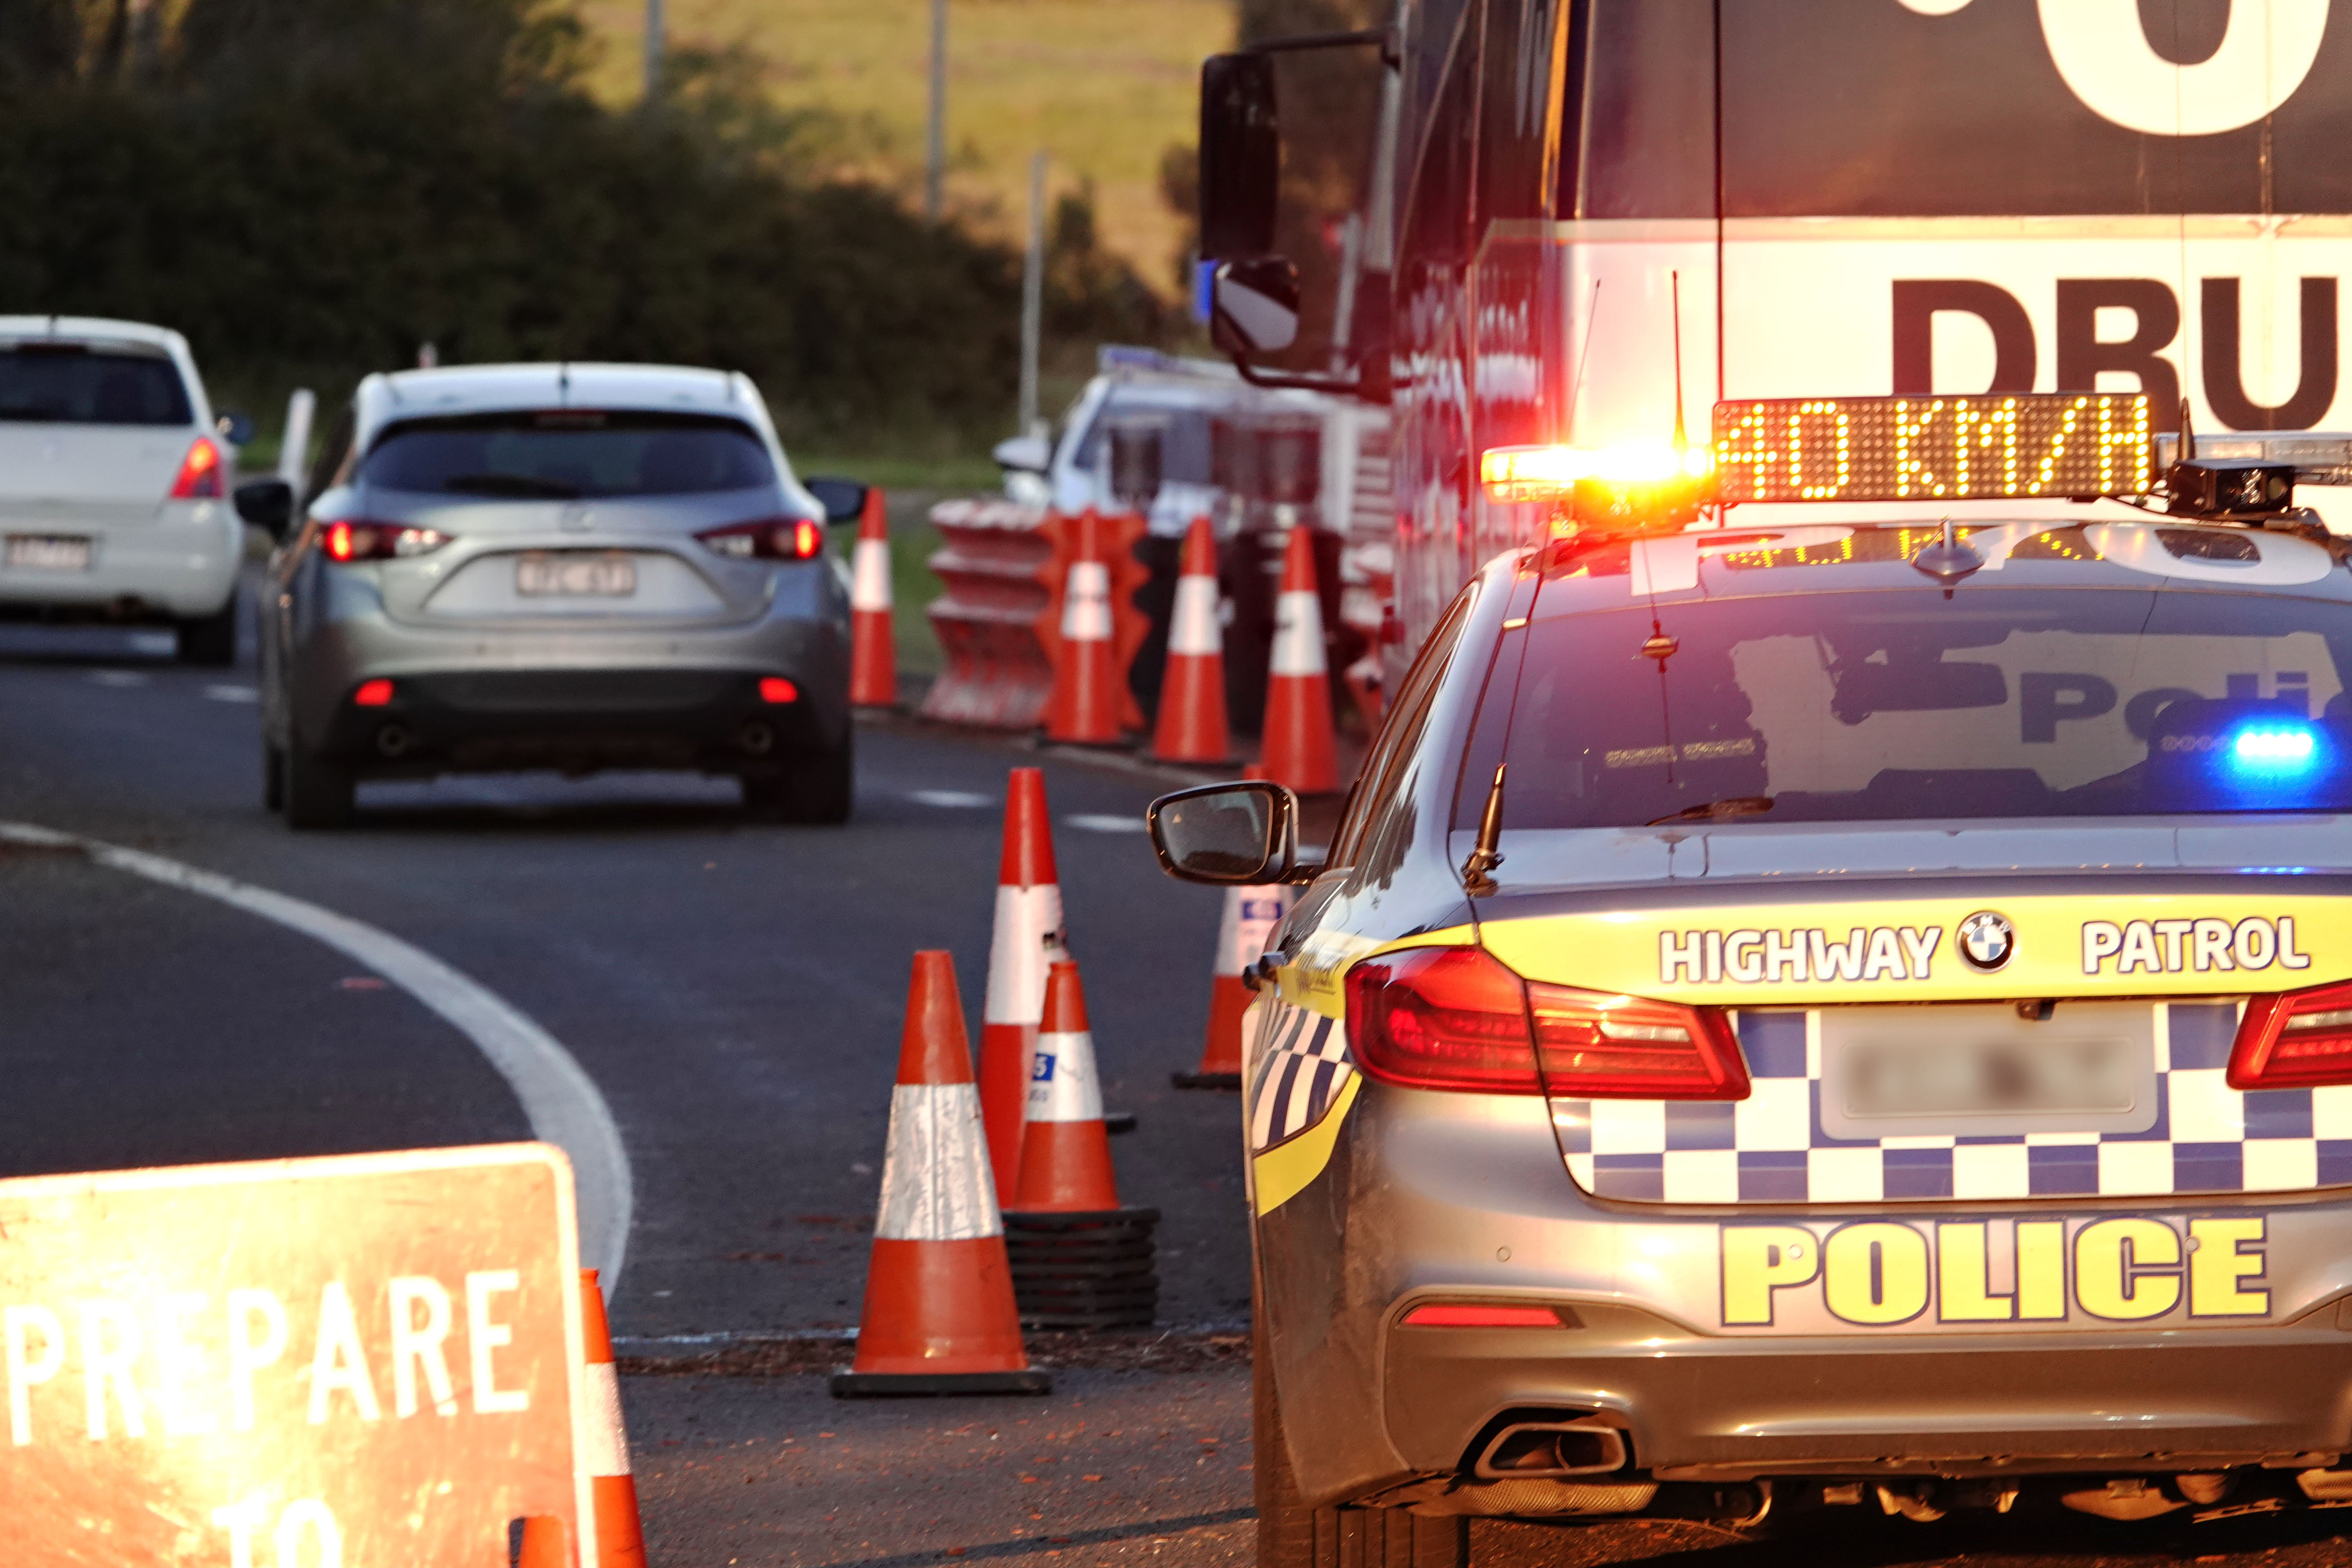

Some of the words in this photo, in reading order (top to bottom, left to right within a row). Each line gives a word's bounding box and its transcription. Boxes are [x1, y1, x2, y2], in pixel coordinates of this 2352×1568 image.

[1717, 401, 1849, 499] 40
[1896, 395, 2149, 497] KM/H
[1659, 926, 1942, 984] HIGHWAY
[2082, 916, 2311, 975] PATROL
[1720, 1215, 2273, 1327] POLICE
[4, 1269, 530, 1447] PREPARE
